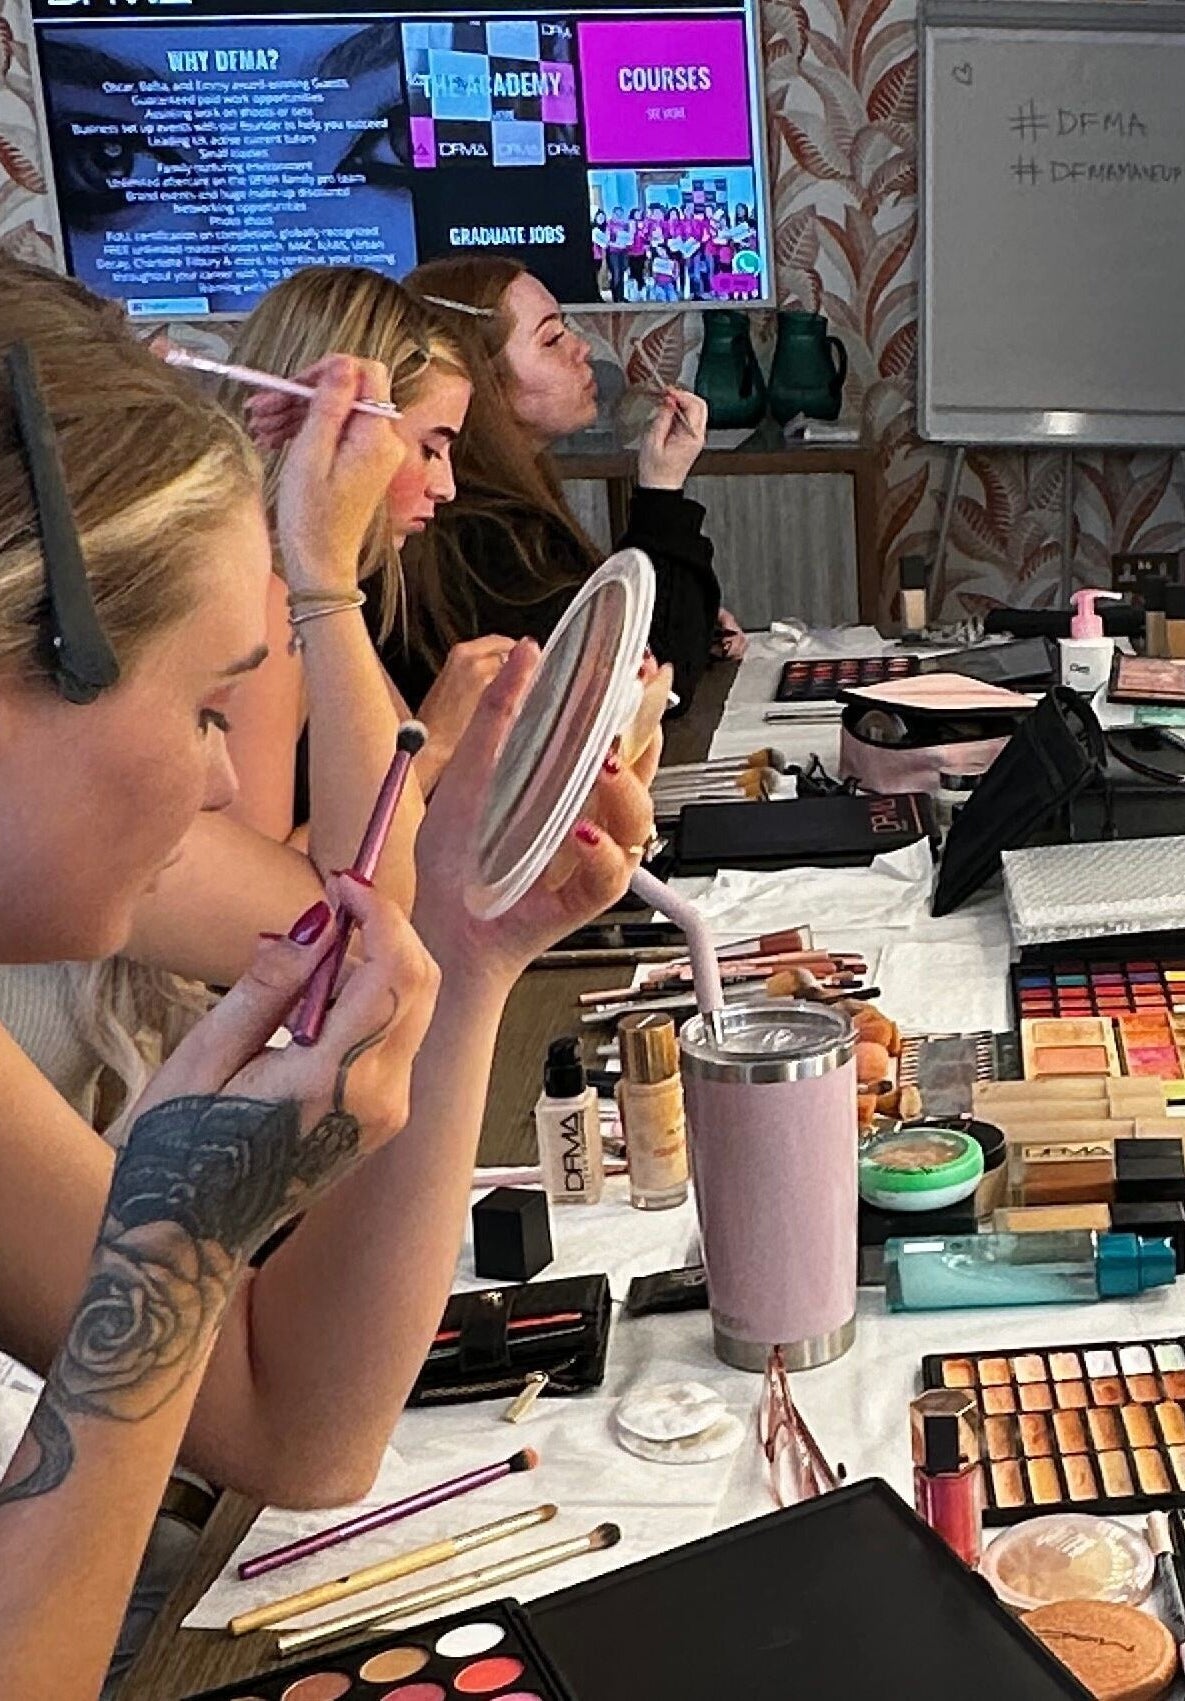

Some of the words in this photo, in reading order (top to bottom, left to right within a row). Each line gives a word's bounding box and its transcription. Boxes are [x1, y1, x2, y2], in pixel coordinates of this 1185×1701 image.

[167, 49, 209, 72] WHY
[215, 48, 280, 72] DFMA?
[419, 73, 465, 98] THE
[466, 71, 562, 97] ACADEMY
[618, 66, 712, 92] COURSES
[449, 225, 526, 246] GRADUATE
[528, 224, 565, 245] JOBS
[560, 1111, 585, 1191] DFMA
